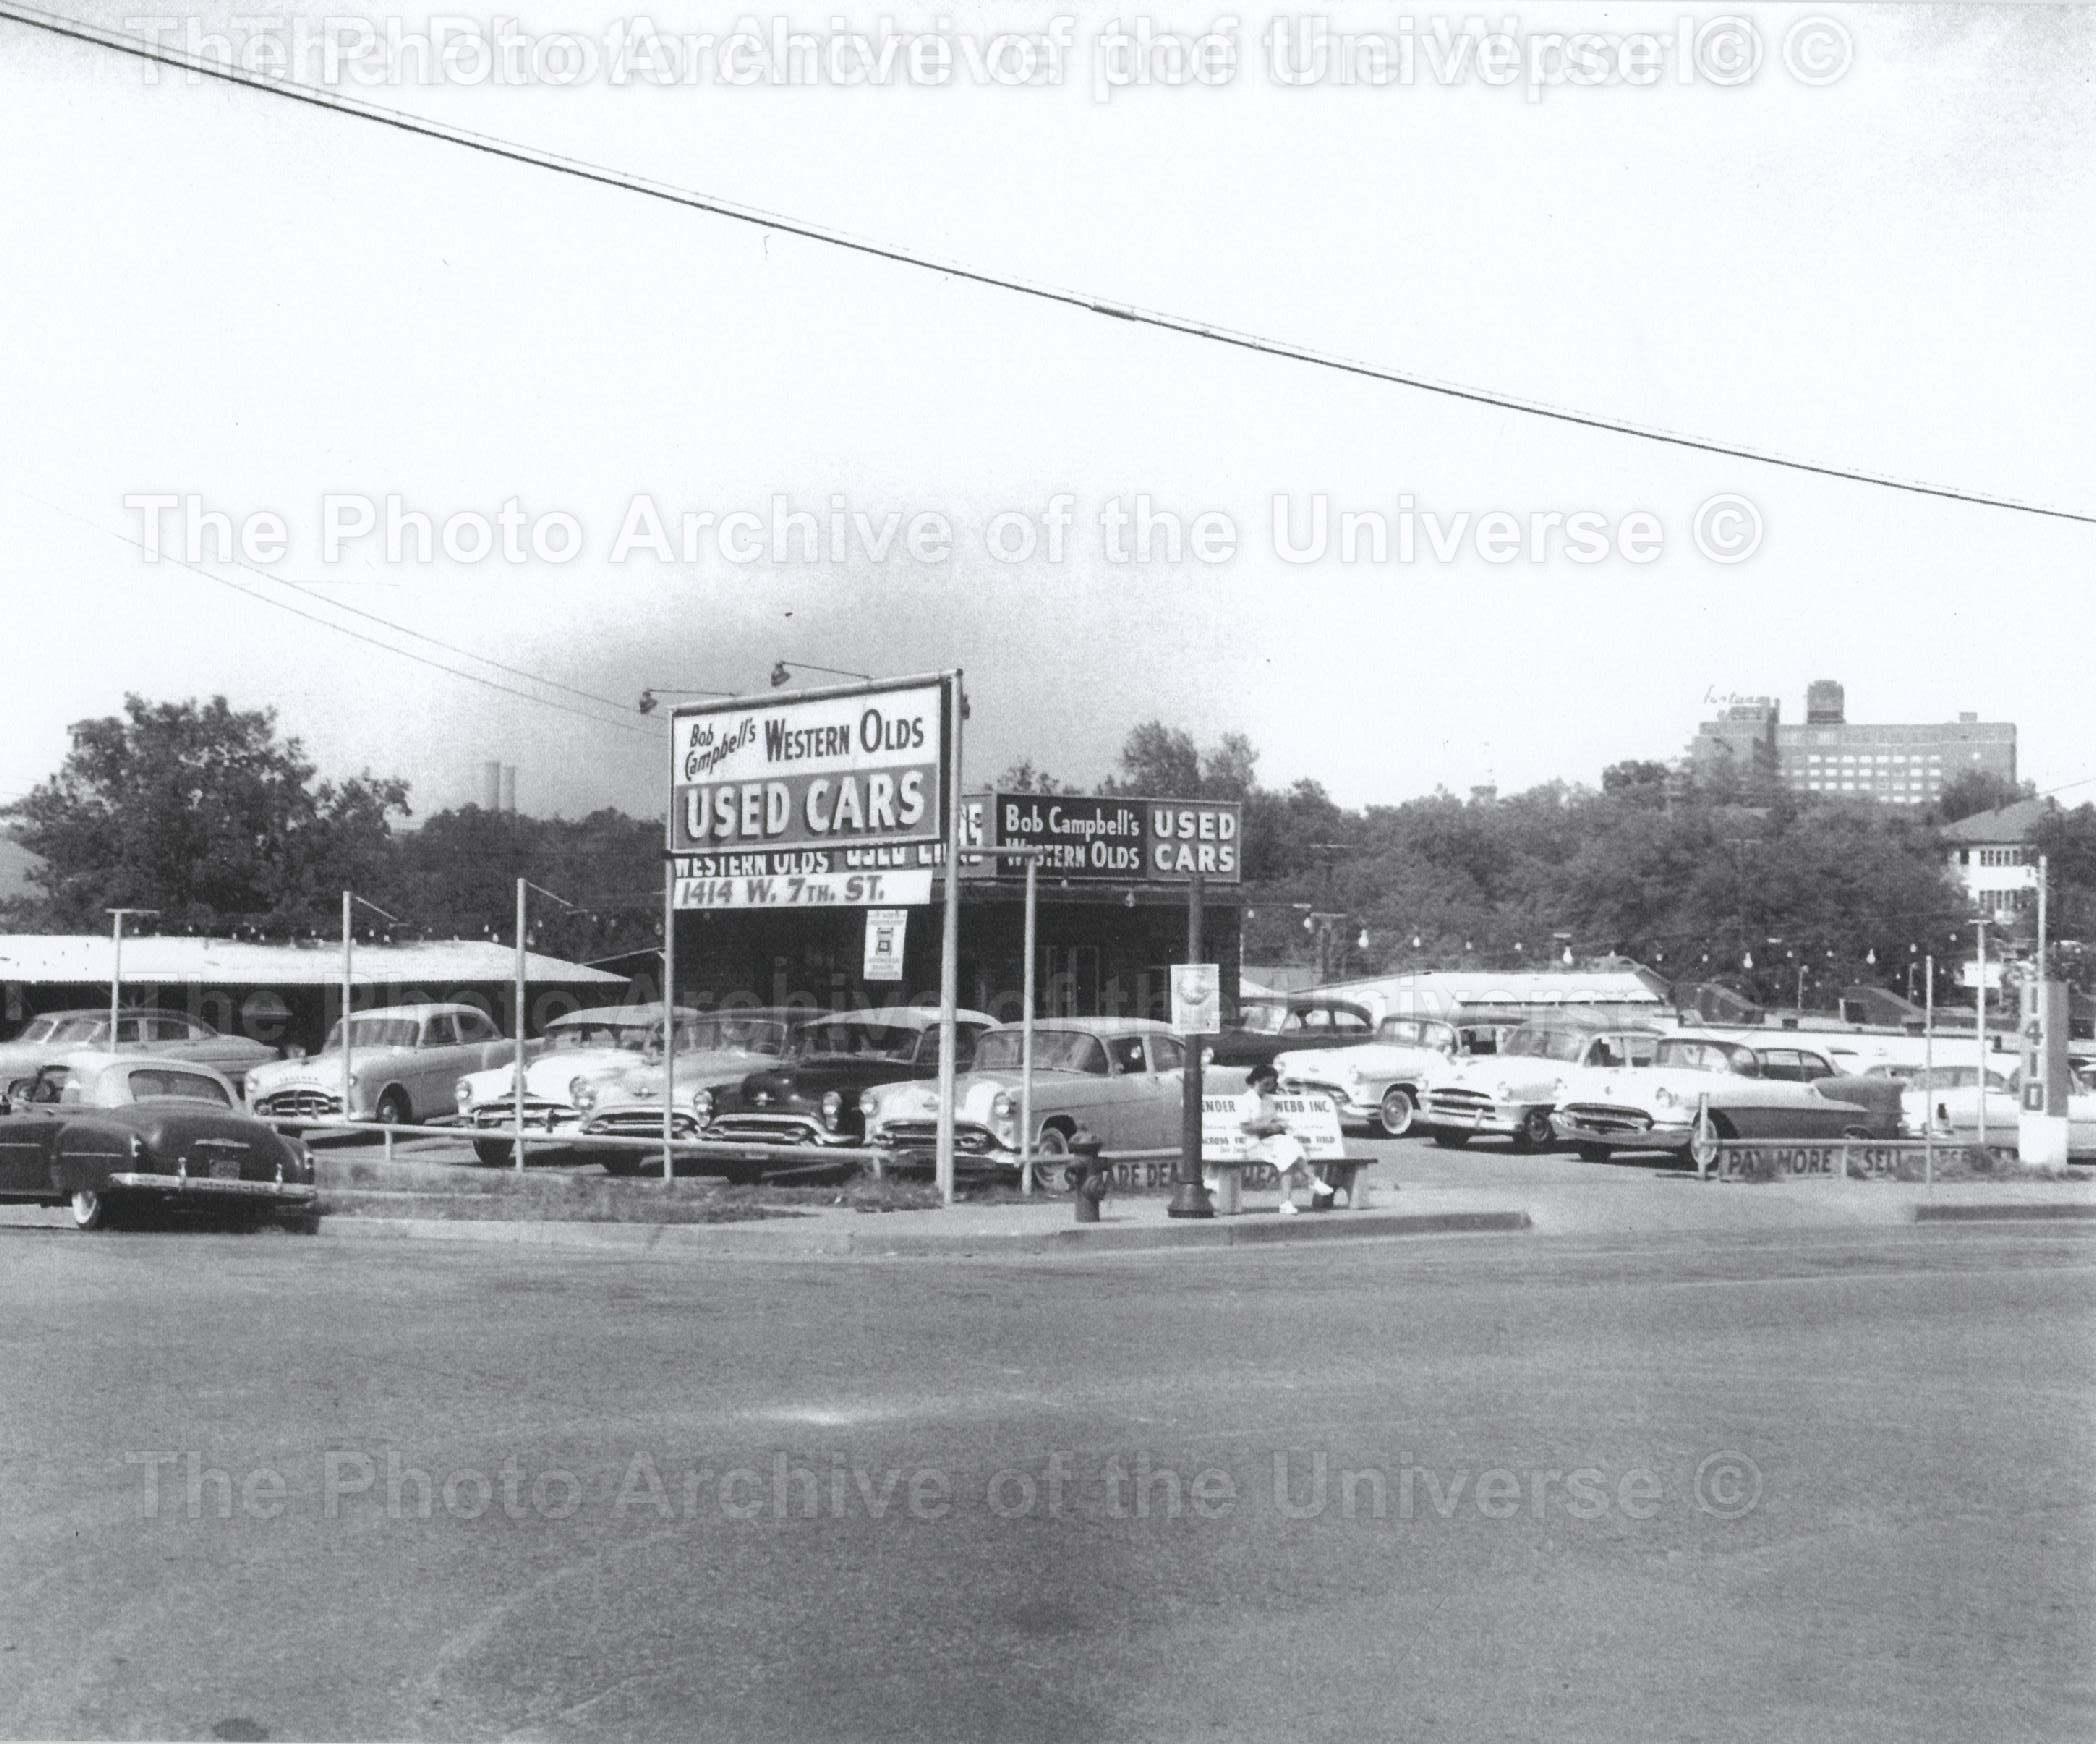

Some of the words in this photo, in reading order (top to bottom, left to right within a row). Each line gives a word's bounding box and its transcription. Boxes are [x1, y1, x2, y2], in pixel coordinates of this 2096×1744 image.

[685, 717, 757, 782] Campbell's
[689, 723, 715, 748] Bob
[765, 718, 850, 762] WESTERN
[859, 708, 925, 753] OLDS
[687, 782, 790, 839] USED
[806, 771, 925, 833] CARS
[1005, 804, 1043, 832] Bob
[1049, 806, 1140, 842] Campbell's
[1154, 809, 1235, 840] USED
[1005, 838, 1086, 868] WSTERN
[1091, 840, 1141, 869] OLDS
[1154, 844, 1235, 872] CARS
[681, 880, 732, 905] 1414
[746, 879, 776, 903] W.
[786, 877, 835, 902] 7TH.
[844, 875, 885, 901] ST.
[2025, 986, 2043, 1111] 1410
[1777, 1149, 1832, 1174] MORE
